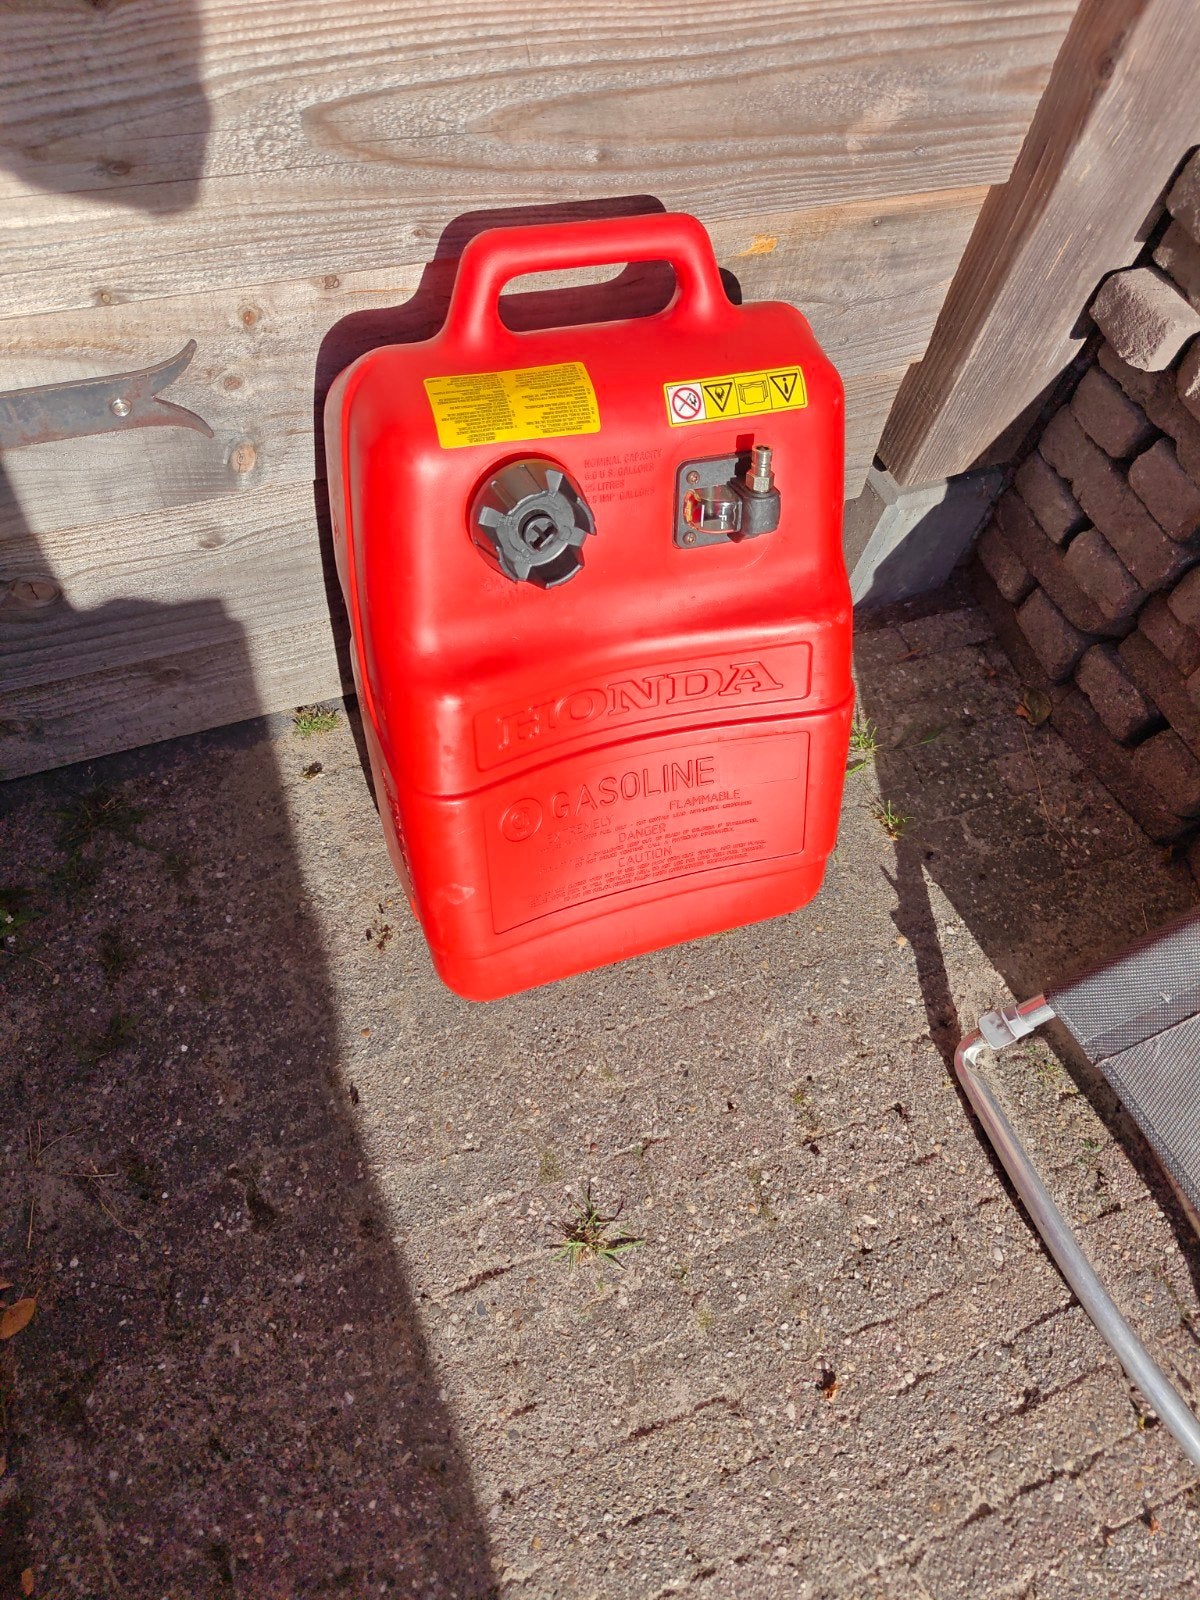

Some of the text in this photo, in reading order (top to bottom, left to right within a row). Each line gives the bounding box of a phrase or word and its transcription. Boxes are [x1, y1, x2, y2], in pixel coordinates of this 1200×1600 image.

[598, 480, 624, 491] LITRES
[497, 660, 784, 751] HONDA
[551, 756, 714, 820] GASOLINE
[669, 788, 740, 810] FLAMMABLE
[618, 822, 666, 842] DANGER
[618, 846, 672, 868] CAUTION
